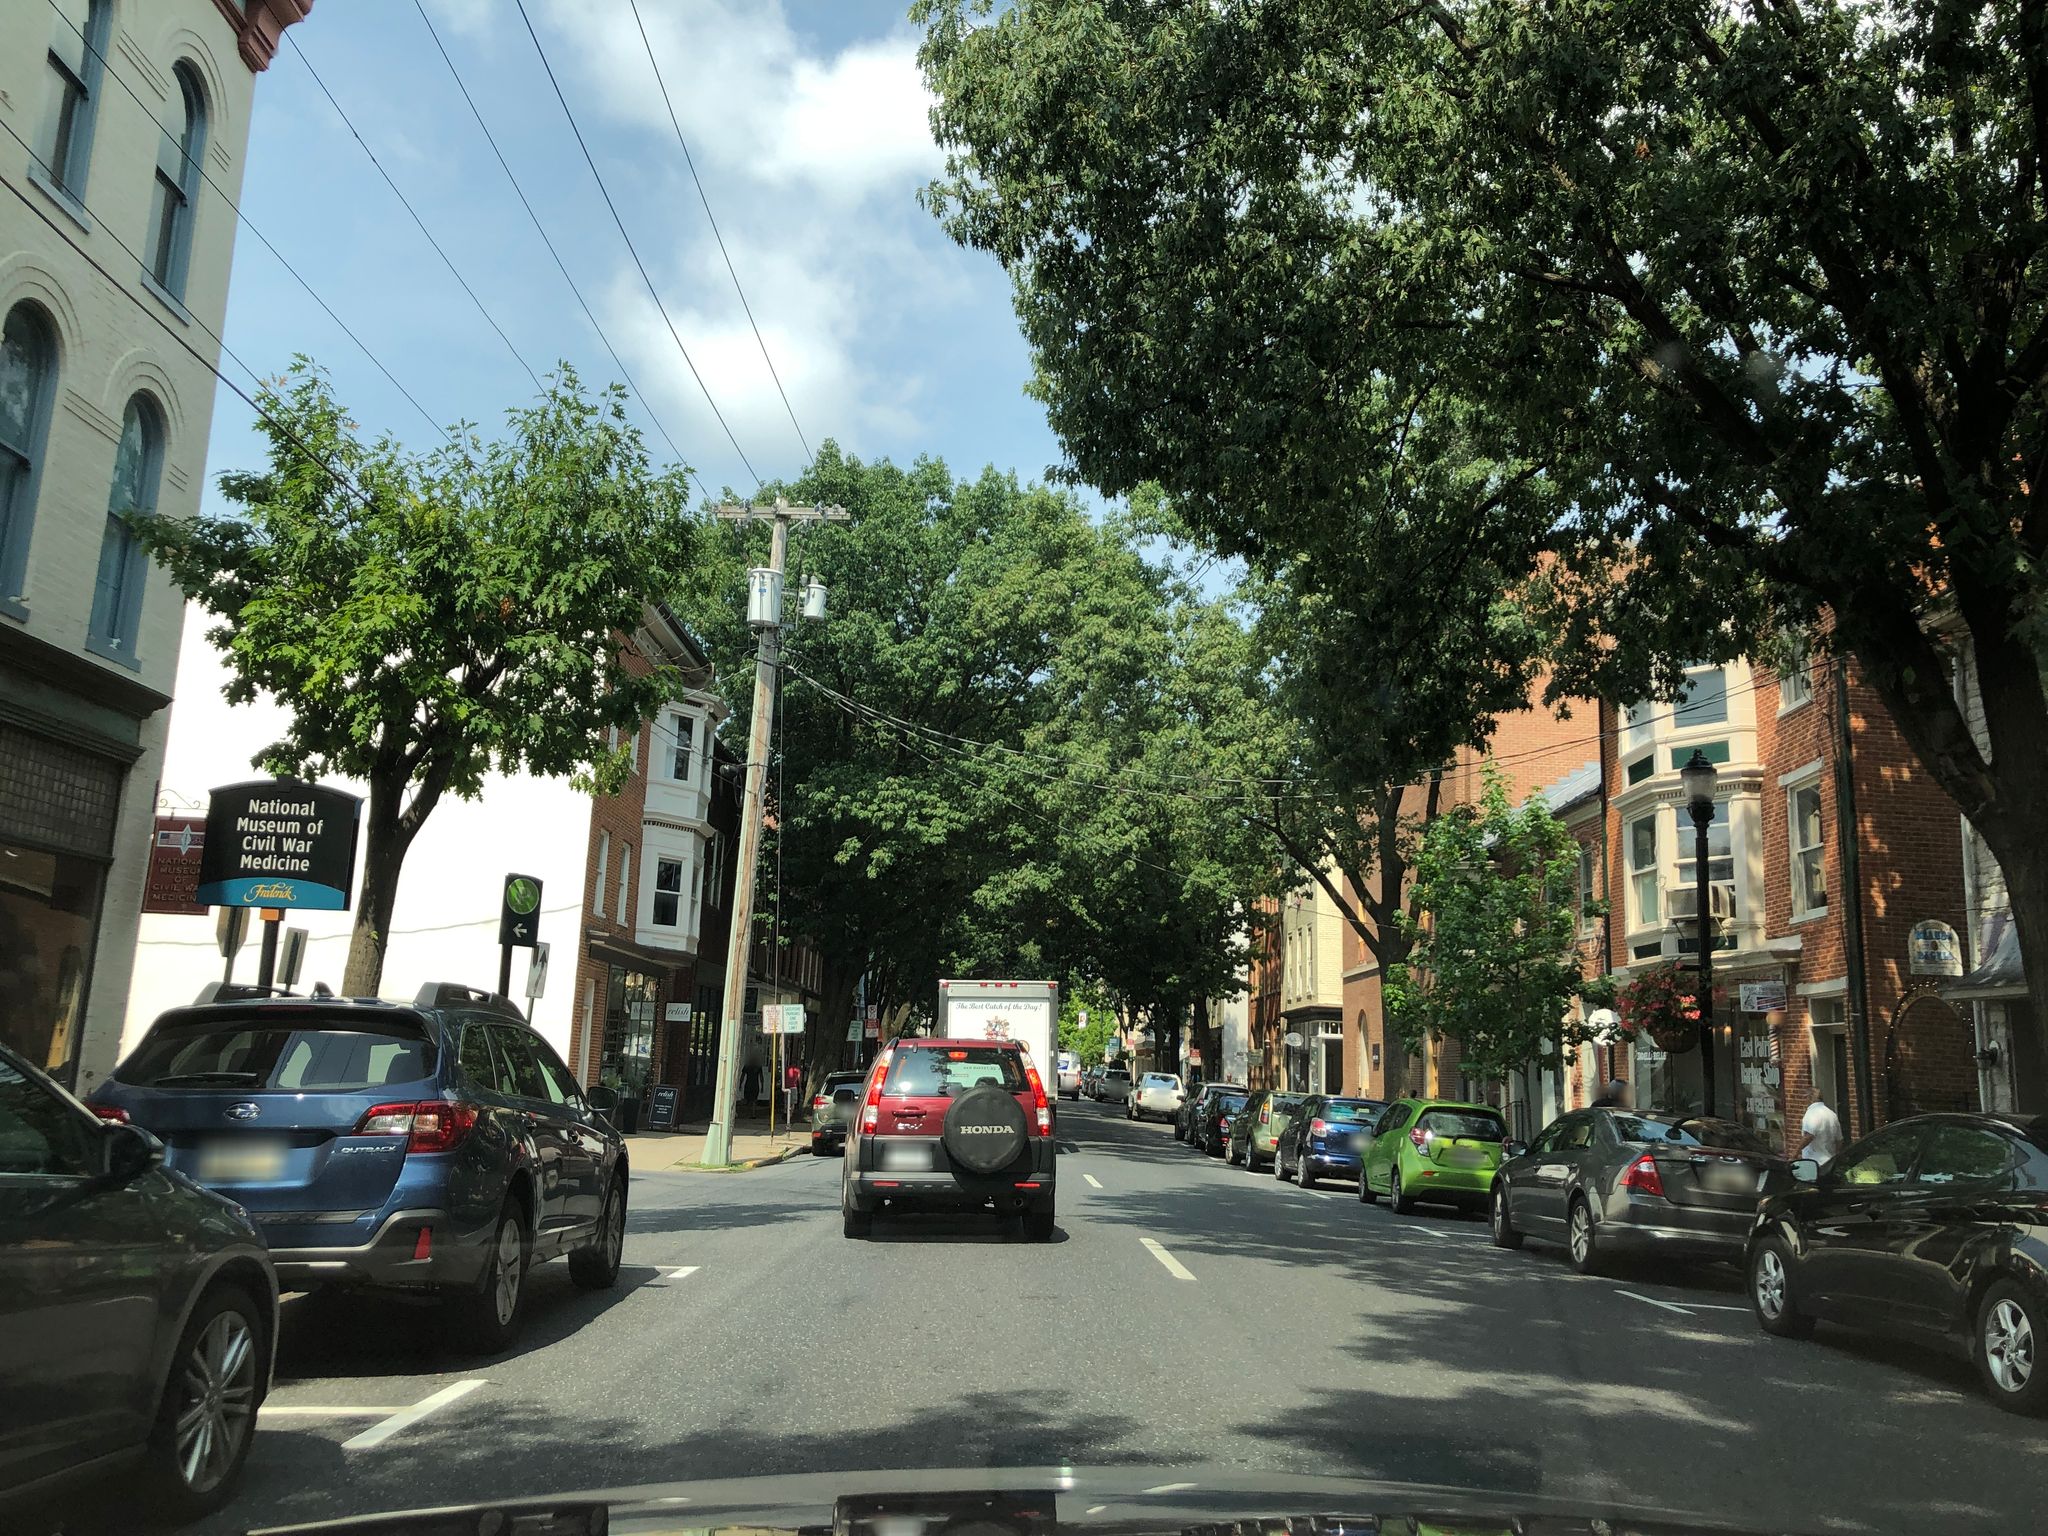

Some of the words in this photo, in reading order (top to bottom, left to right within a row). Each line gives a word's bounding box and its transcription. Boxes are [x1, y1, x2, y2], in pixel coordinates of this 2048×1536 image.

[248, 799, 316, 817] National
[236, 817, 300, 834] Museum
[306, 819, 324, 835] of
[242, 835, 276, 852] Civil
[282, 837, 314, 853] War
[239, 854, 310, 872] Medicine
[152, 883, 181, 891] CIVIL
[185, 884, 199, 892] WA
[243, 882, 297, 903] Frederick
[152, 894, 197, 902] MEDICIN
[667, 1007, 690, 1016] relish
[956, 1002, 968, 1010] The
[1004, 1003, 1011, 1011] of
[1023, 1003, 1043, 1012] Day!
[1740, 1036, 1753, 1058] East
[1754, 1036, 1771, 1058] Patri
[1740, 1062, 1762, 1085] Barber
[1763, 1061, 1780, 1089] Shop
[960, 1125, 1015, 1134] HONDA
[341, 1145, 397, 1154] OUTBACK
